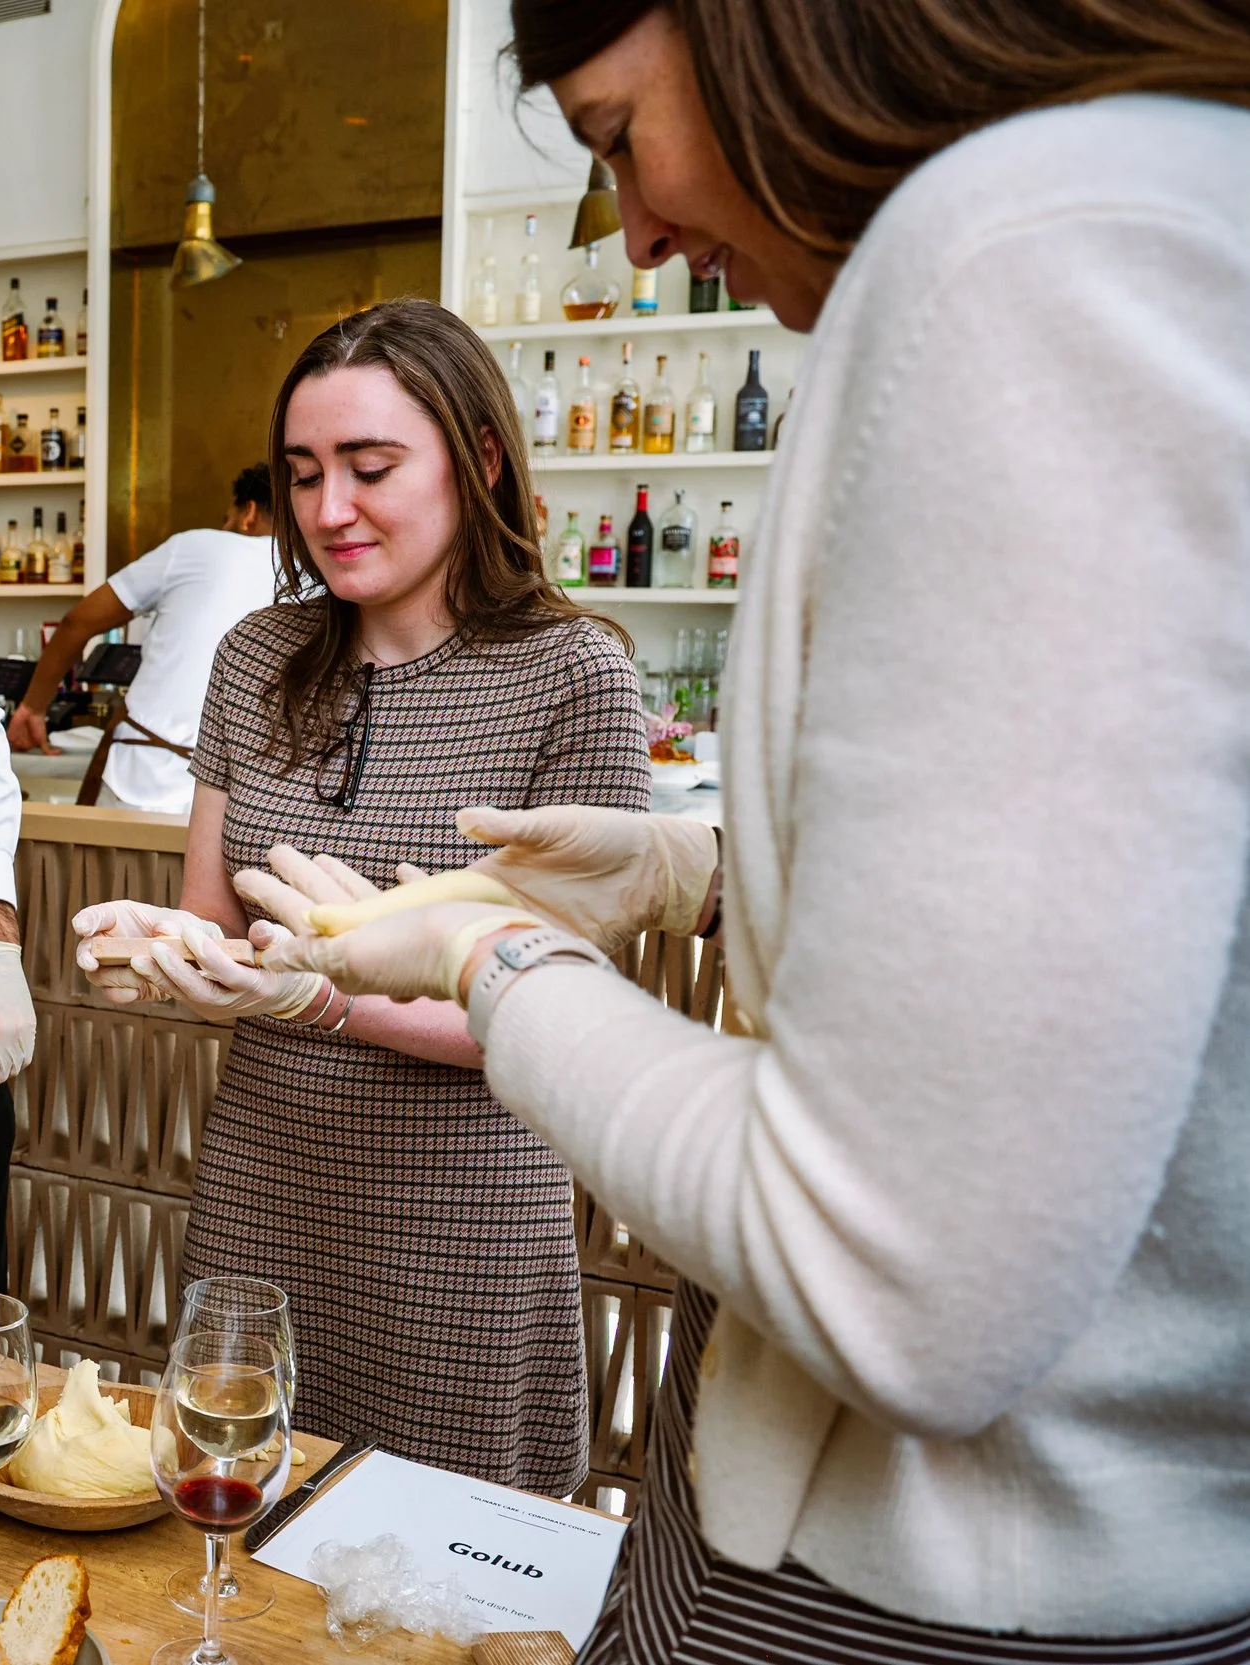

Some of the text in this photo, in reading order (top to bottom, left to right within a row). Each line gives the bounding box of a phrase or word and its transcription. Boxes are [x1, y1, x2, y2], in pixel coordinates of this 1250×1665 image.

[470, 1495, 501, 1507] CULINARY
[528, 1512, 567, 1526] CORPORATE
[448, 1542, 544, 1579] Golub
[486, 1601, 508, 1613] dish
